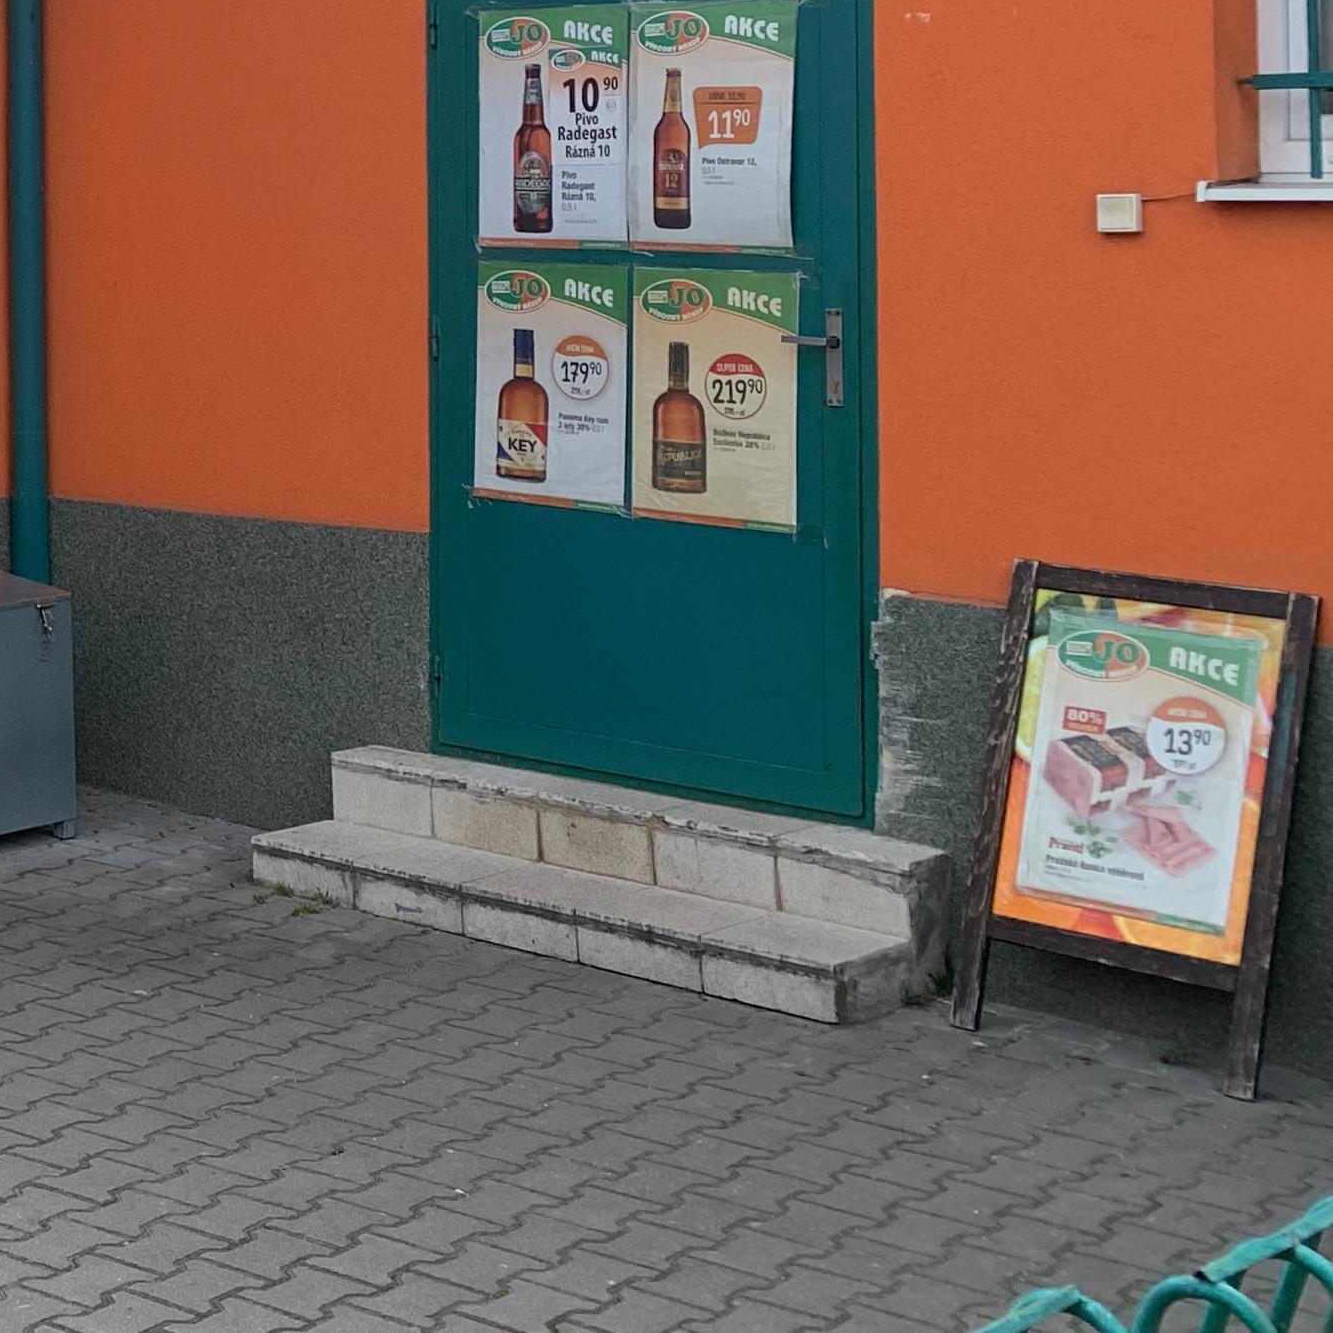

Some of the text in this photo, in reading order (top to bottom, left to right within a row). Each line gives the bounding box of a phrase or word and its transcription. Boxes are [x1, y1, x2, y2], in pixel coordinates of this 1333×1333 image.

[563, 19, 613, 45] AKCE
[724, 14, 780, 43] AKCE
[591, 50, 620, 64] AKCE
[575, 112, 599, 126] Pivo
[557, 125, 618, 144] Radegast
[565, 144, 611, 159] Rázná 10
[563, 277, 614, 308] AKCE
[727, 286, 782, 318] AKCE
[507, 436, 539, 454] KEY
[1169, 646, 1241, 687] AKCE
